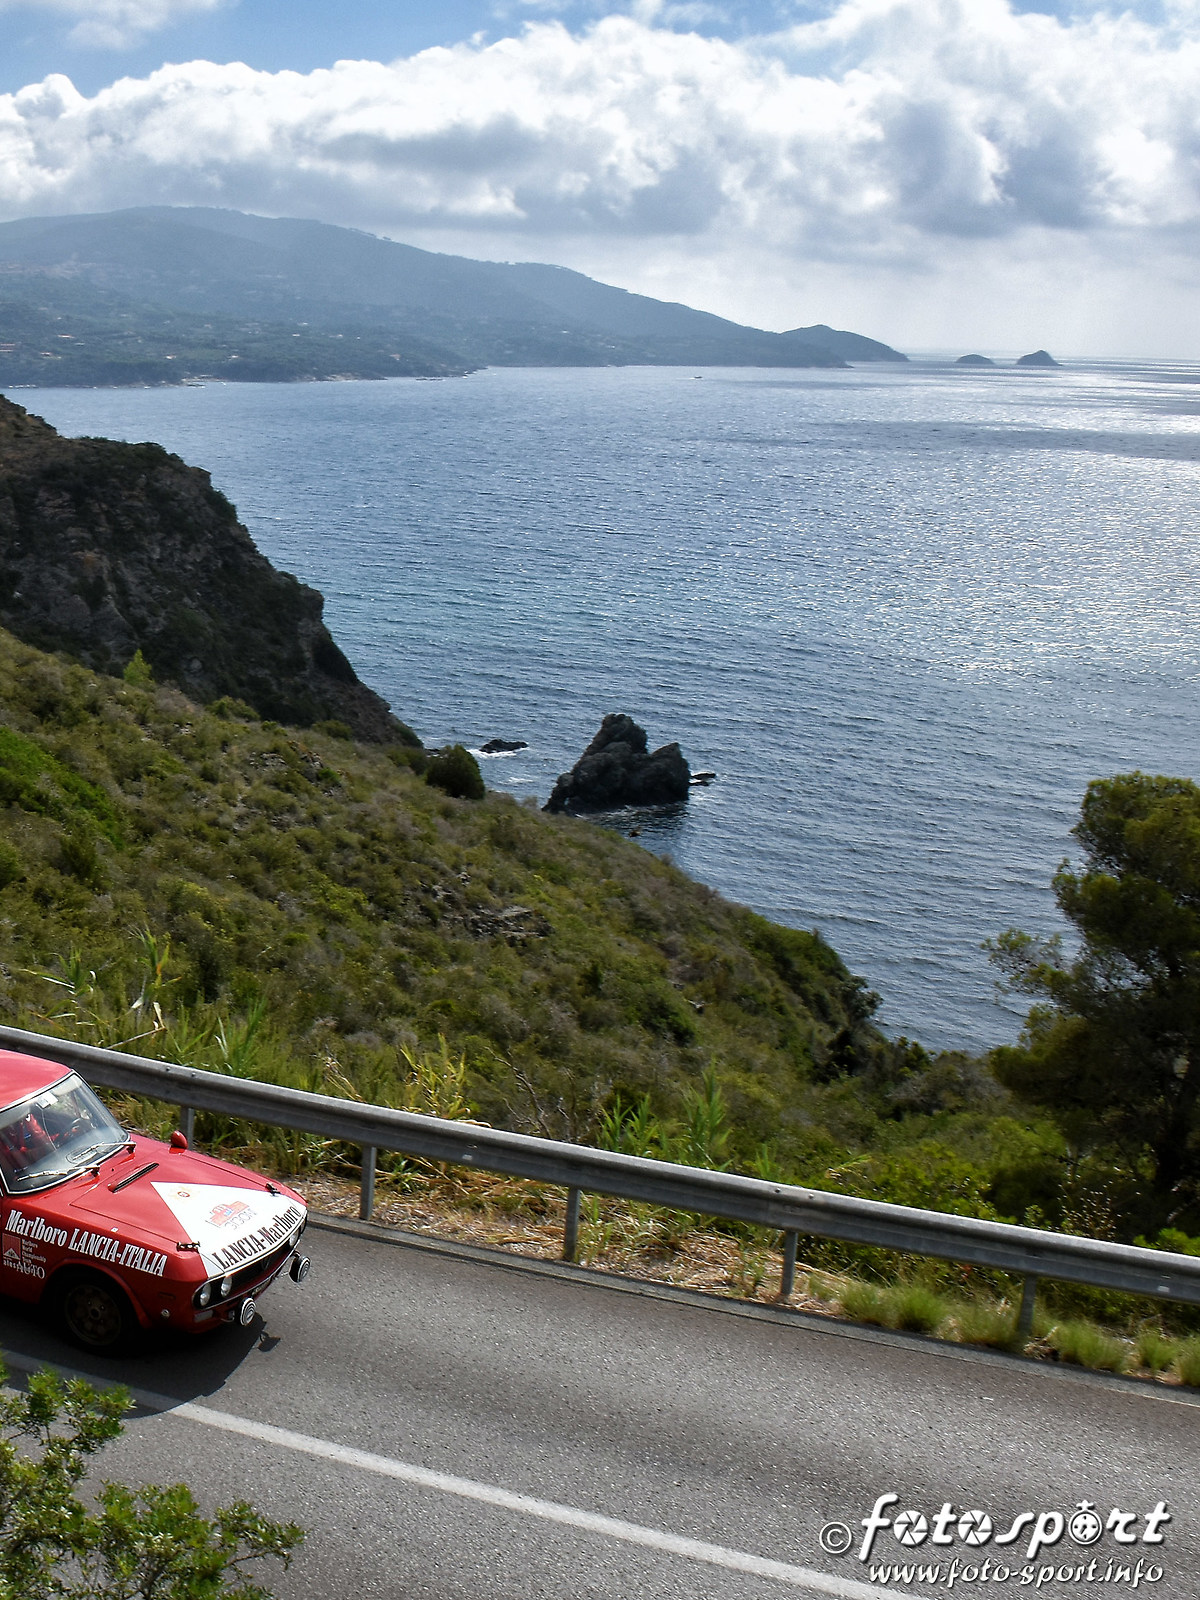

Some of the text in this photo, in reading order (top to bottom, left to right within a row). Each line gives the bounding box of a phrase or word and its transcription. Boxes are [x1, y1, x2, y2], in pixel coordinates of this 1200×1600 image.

[5, 1209, 168, 1277] Marlboro LANCIA-ITALIA
[212, 1206, 302, 1270] LANCIA-Marlboro
